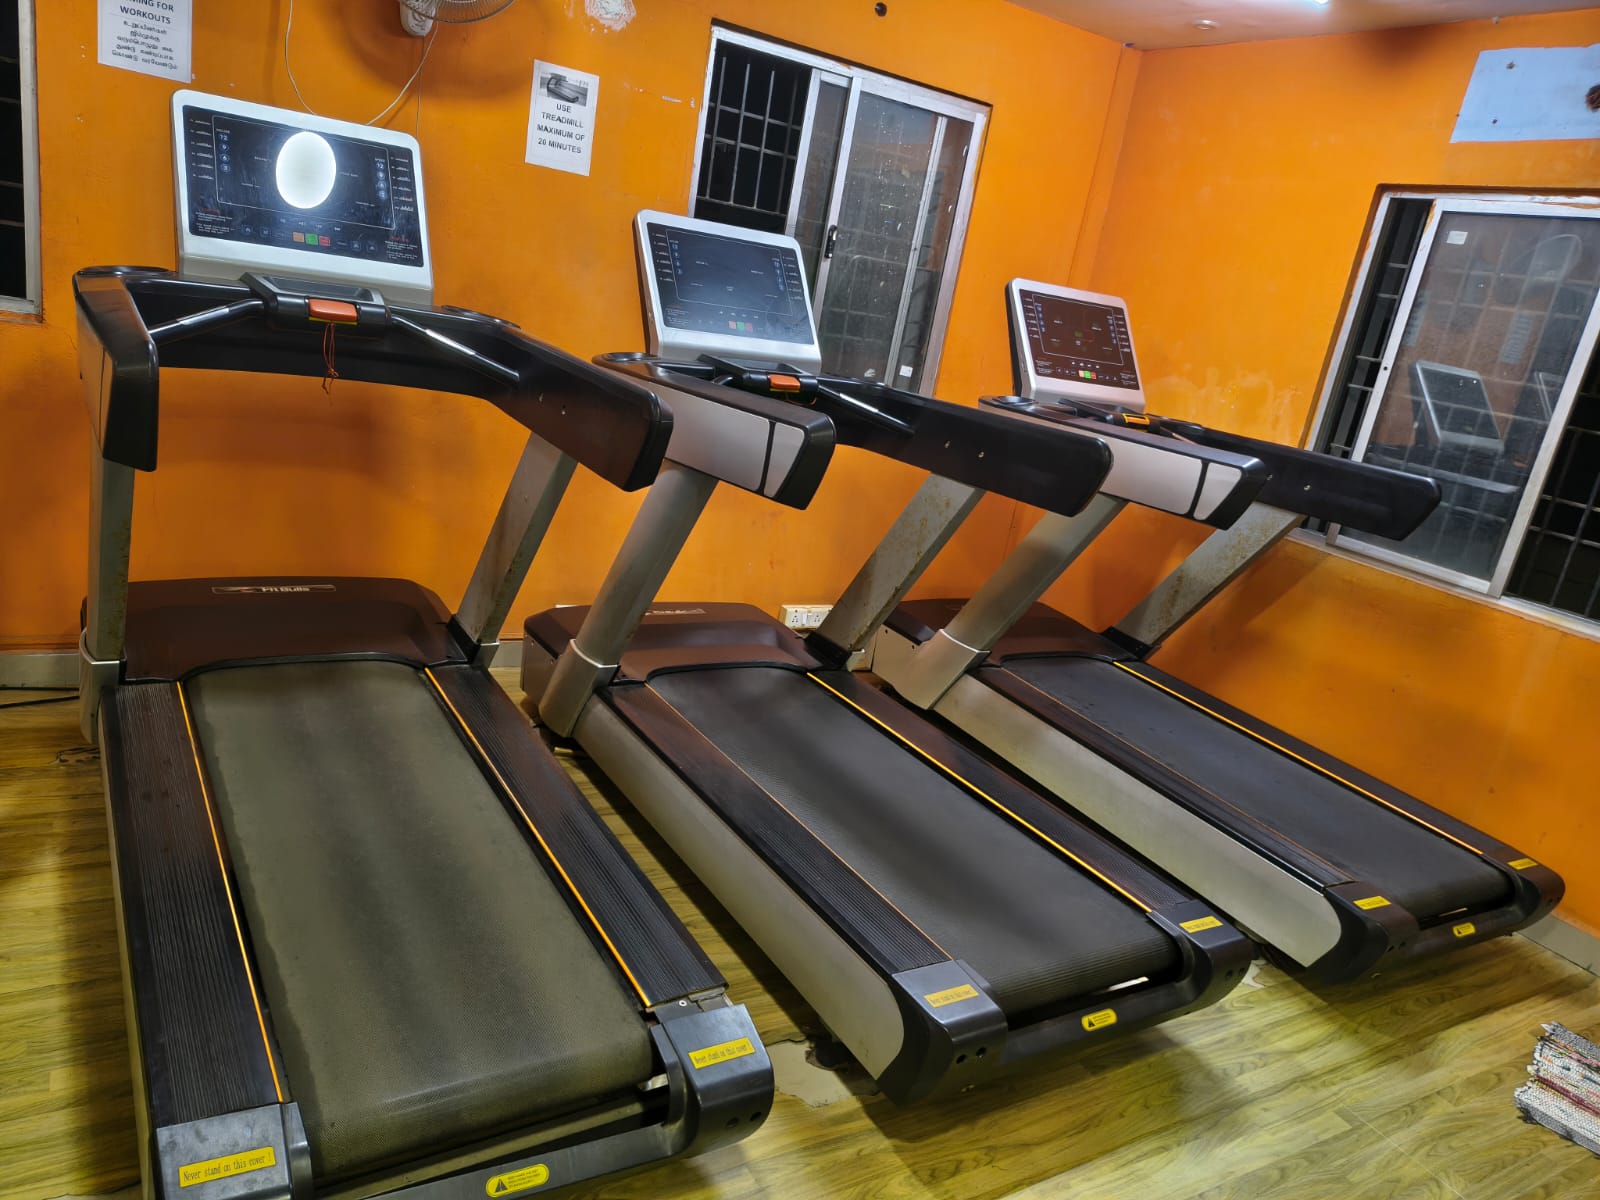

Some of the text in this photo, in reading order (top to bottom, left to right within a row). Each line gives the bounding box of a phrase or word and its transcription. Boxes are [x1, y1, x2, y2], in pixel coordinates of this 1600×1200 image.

[120, 5, 171, 24] WORKOUTS
[156, 1, 174, 12] FOR
[556, 104, 572, 113] USE
[541, 111, 584, 129] TREADMILL
[536, 123, 585, 142] MAXIMUM OF
[538, 137, 582, 154] 20 MINUTES
[183, 1170, 201, 1182] Never
[204, 1163, 221, 1178] stand
[223, 1164, 232, 1173] on
[233, 1158, 247, 1170] this
[249, 1155, 265, 1167] cover
